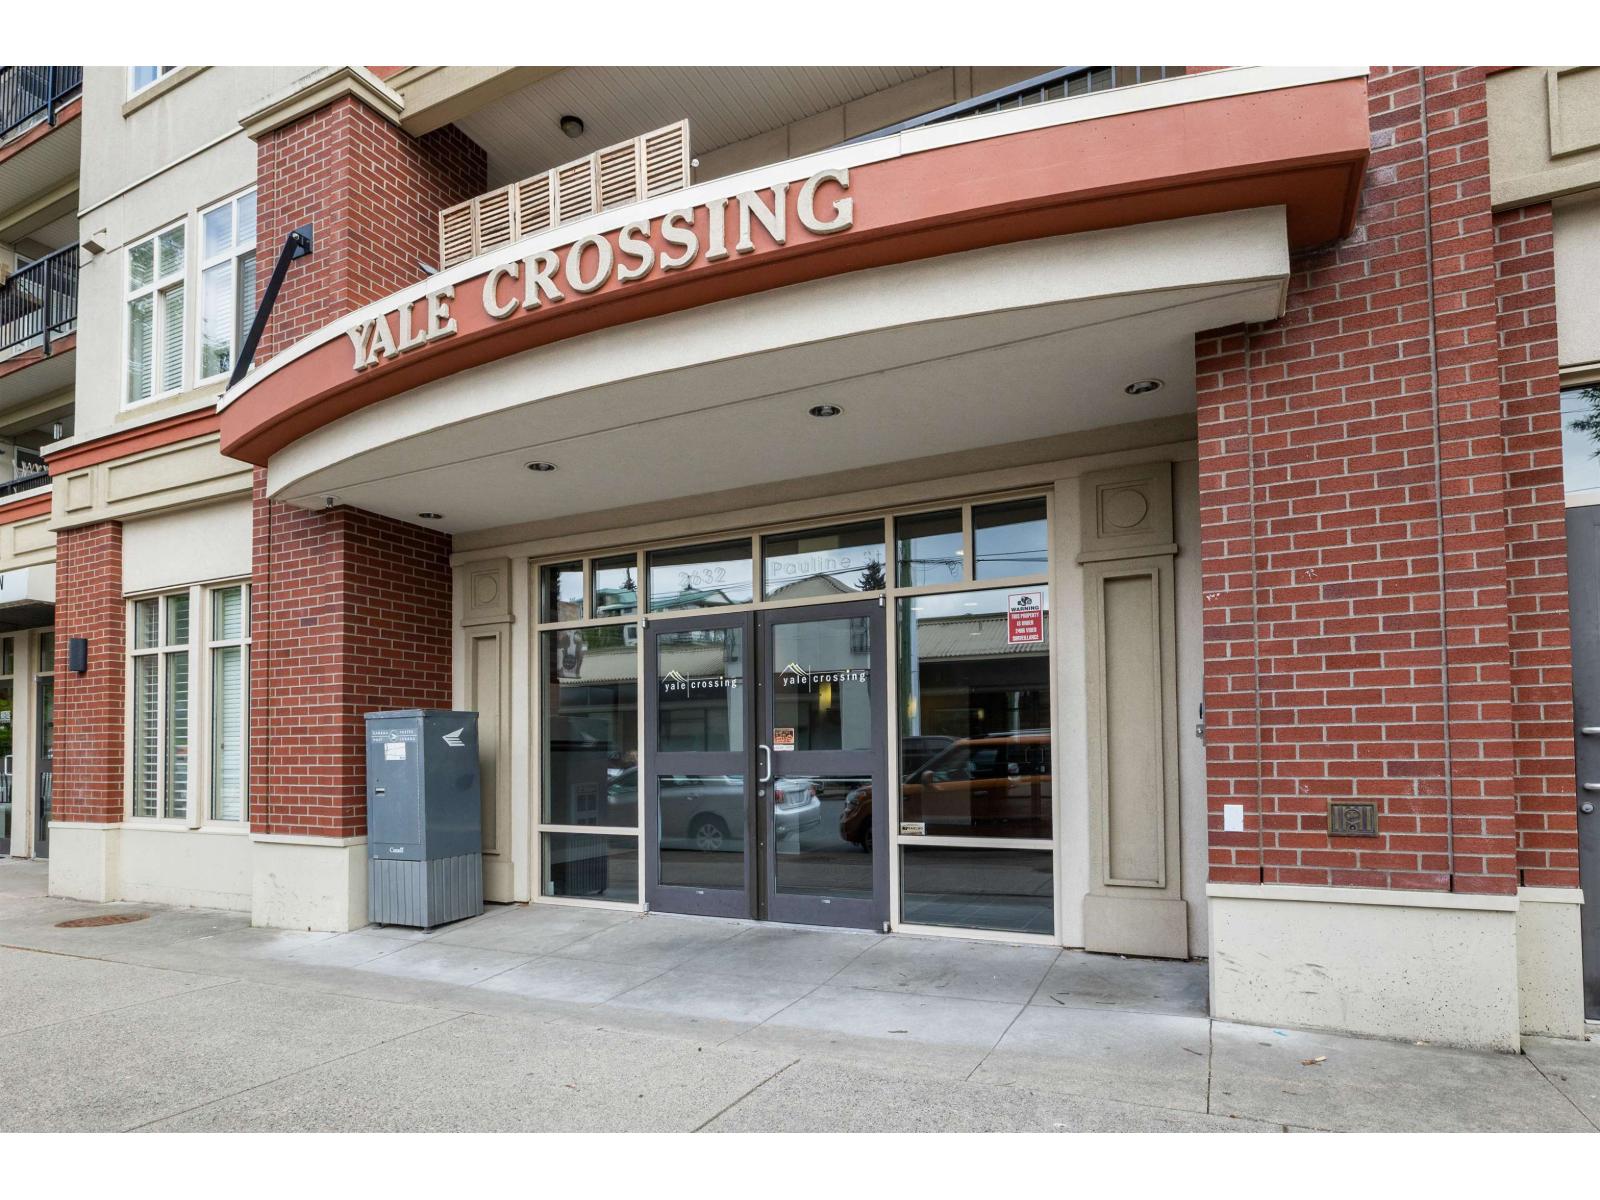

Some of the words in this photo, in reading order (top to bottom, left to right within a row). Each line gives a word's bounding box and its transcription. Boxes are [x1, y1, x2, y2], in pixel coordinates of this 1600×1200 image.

[346, 285, 457, 371] YALE
[482, 168, 854, 319] CROSSING
[678, 567, 727, 588] 2632
[771, 555, 852, 577] Pauline
[664, 681, 686, 693] yale
[691, 676, 737, 689] crossing
[783, 674, 807, 687] yale
[813, 669, 866, 684] crossing
